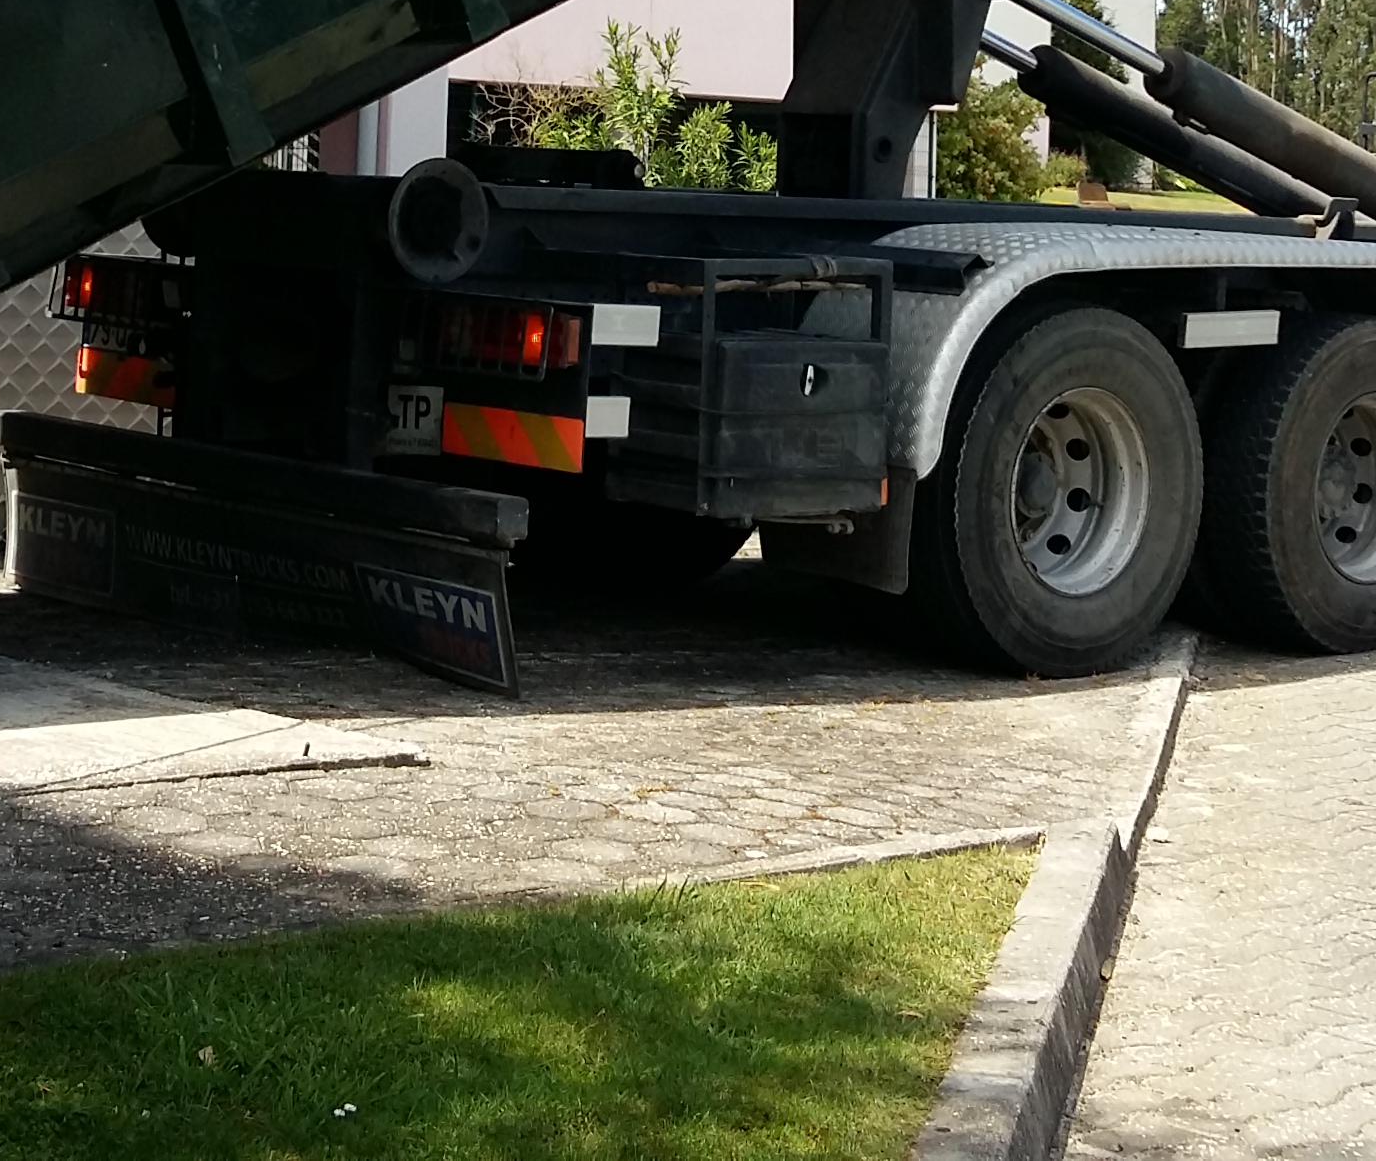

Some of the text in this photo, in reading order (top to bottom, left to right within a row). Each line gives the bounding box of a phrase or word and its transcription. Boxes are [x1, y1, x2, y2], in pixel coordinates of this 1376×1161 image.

[398, 394, 431, 430] TP
[18, 502, 106, 548] KLEYN
[126, 524, 352, 592] WWW.KLEYNTRUCKS.COM
[367, 574, 487, 633] KLEYN
